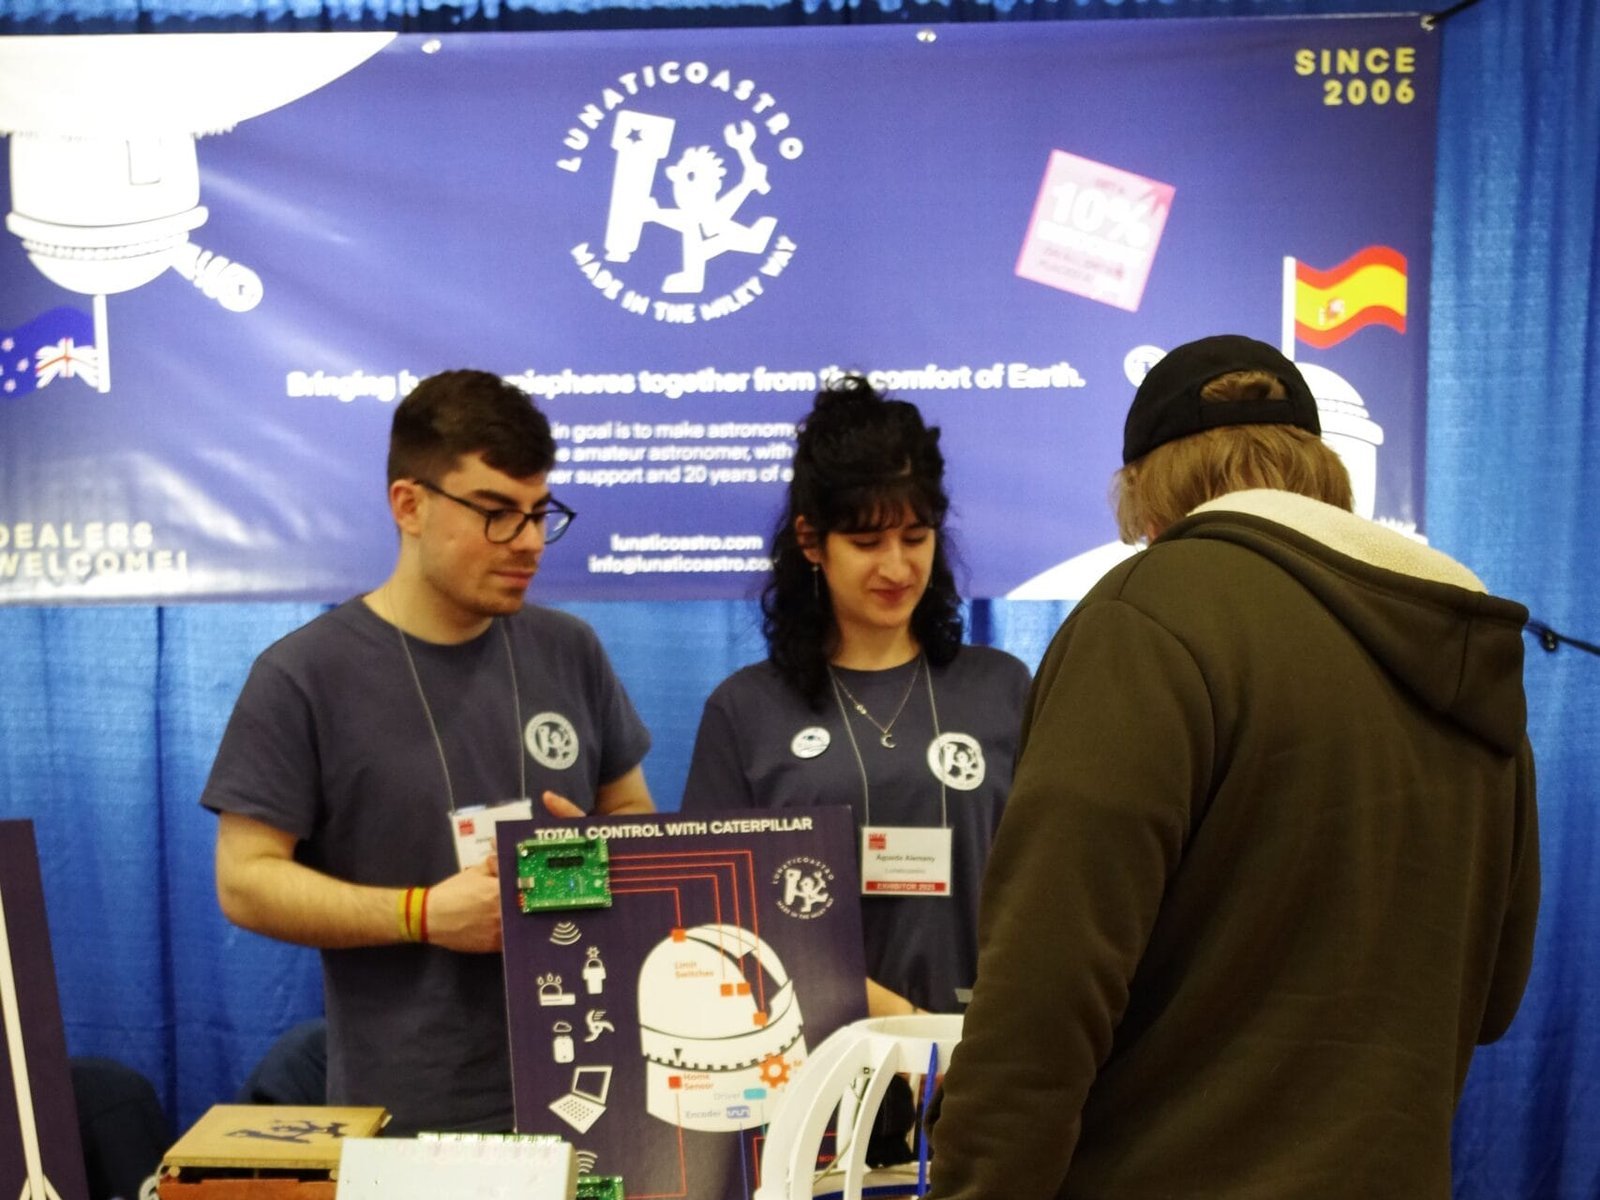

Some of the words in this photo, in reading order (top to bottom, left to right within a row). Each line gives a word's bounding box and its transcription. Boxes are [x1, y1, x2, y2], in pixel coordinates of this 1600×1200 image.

[1294, 47, 1416, 76] SINCE
[1323, 78, 1415, 105] 2006
[556, 61, 803, 172] LUNATICOASTRO
[621, 290, 650, 315] IN
[654, 301, 696, 324] THE
[638, 367, 750, 399] together
[754, 366, 816, 391] from
[867, 365, 973, 391] comfort
[975, 363, 1004, 390] of
[1007, 362, 1086, 388] Earth.
[572, 420, 612, 443] goal
[614, 421, 631, 438] is
[633, 422, 652, 438] to
[654, 420, 705, 438] make
[572, 445, 648, 462] amateur
[575, 467, 643, 487] support
[646, 466, 681, 484] and
[683, 465, 707, 483] 20
[709, 467, 757, 487] years
[760, 464, 779, 483] of
[0, 521, 153, 549] DEALERS
[611, 533, 763, 552] lunaticoastro.com
[588, 554, 776, 574] info@lunaticoastro.co
[585, 822, 664, 841] CONTROL
[666, 820, 708, 837] WITH
[710, 816, 814, 835] CATERPILLAR
